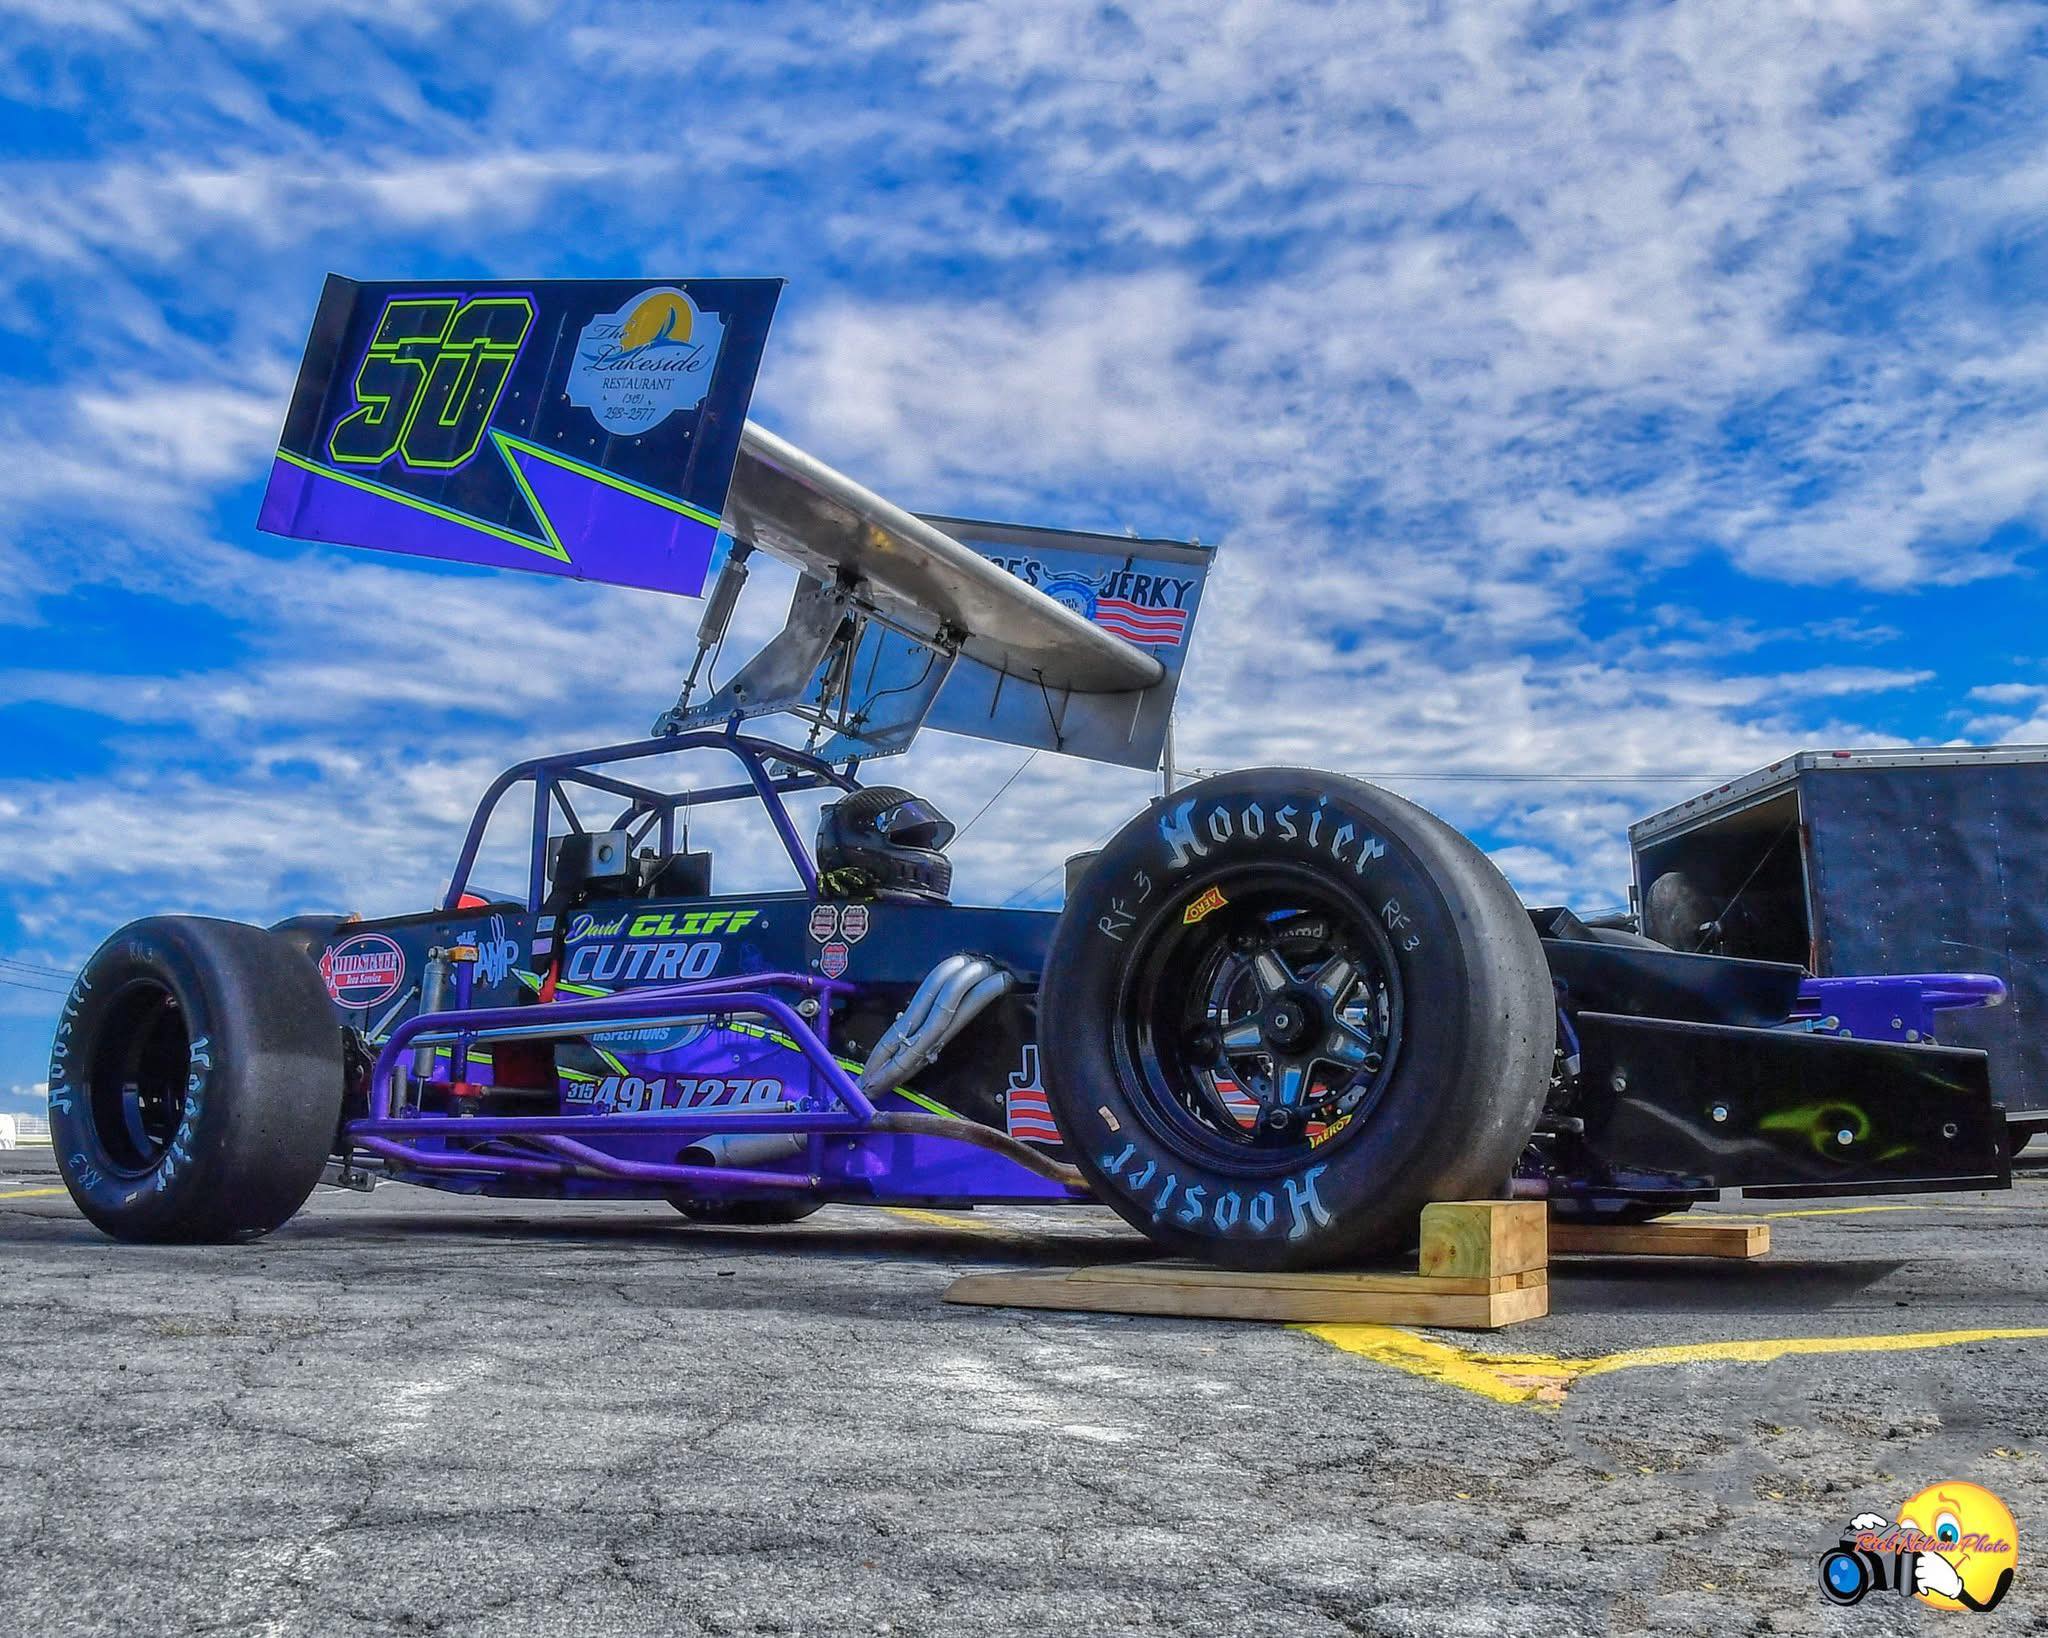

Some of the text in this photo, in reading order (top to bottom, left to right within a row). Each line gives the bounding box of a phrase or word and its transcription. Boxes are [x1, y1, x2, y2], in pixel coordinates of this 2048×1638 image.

[583, 344, 711, 373] Lakeside
[330, 296, 538, 468] 50
[602, 377, 674, 391] RESTAURANT
[1099, 571, 1194, 608] JERKY
[1160, 795, 1384, 874] Hoosier
[1190, 891, 1217, 918] AERO
[564, 910, 760, 944] David CLIFF
[567, 941, 722, 982] CUTRO
[567, 1082, 595, 1100] 315
[1103, 1143, 1332, 1240] Hoosier
